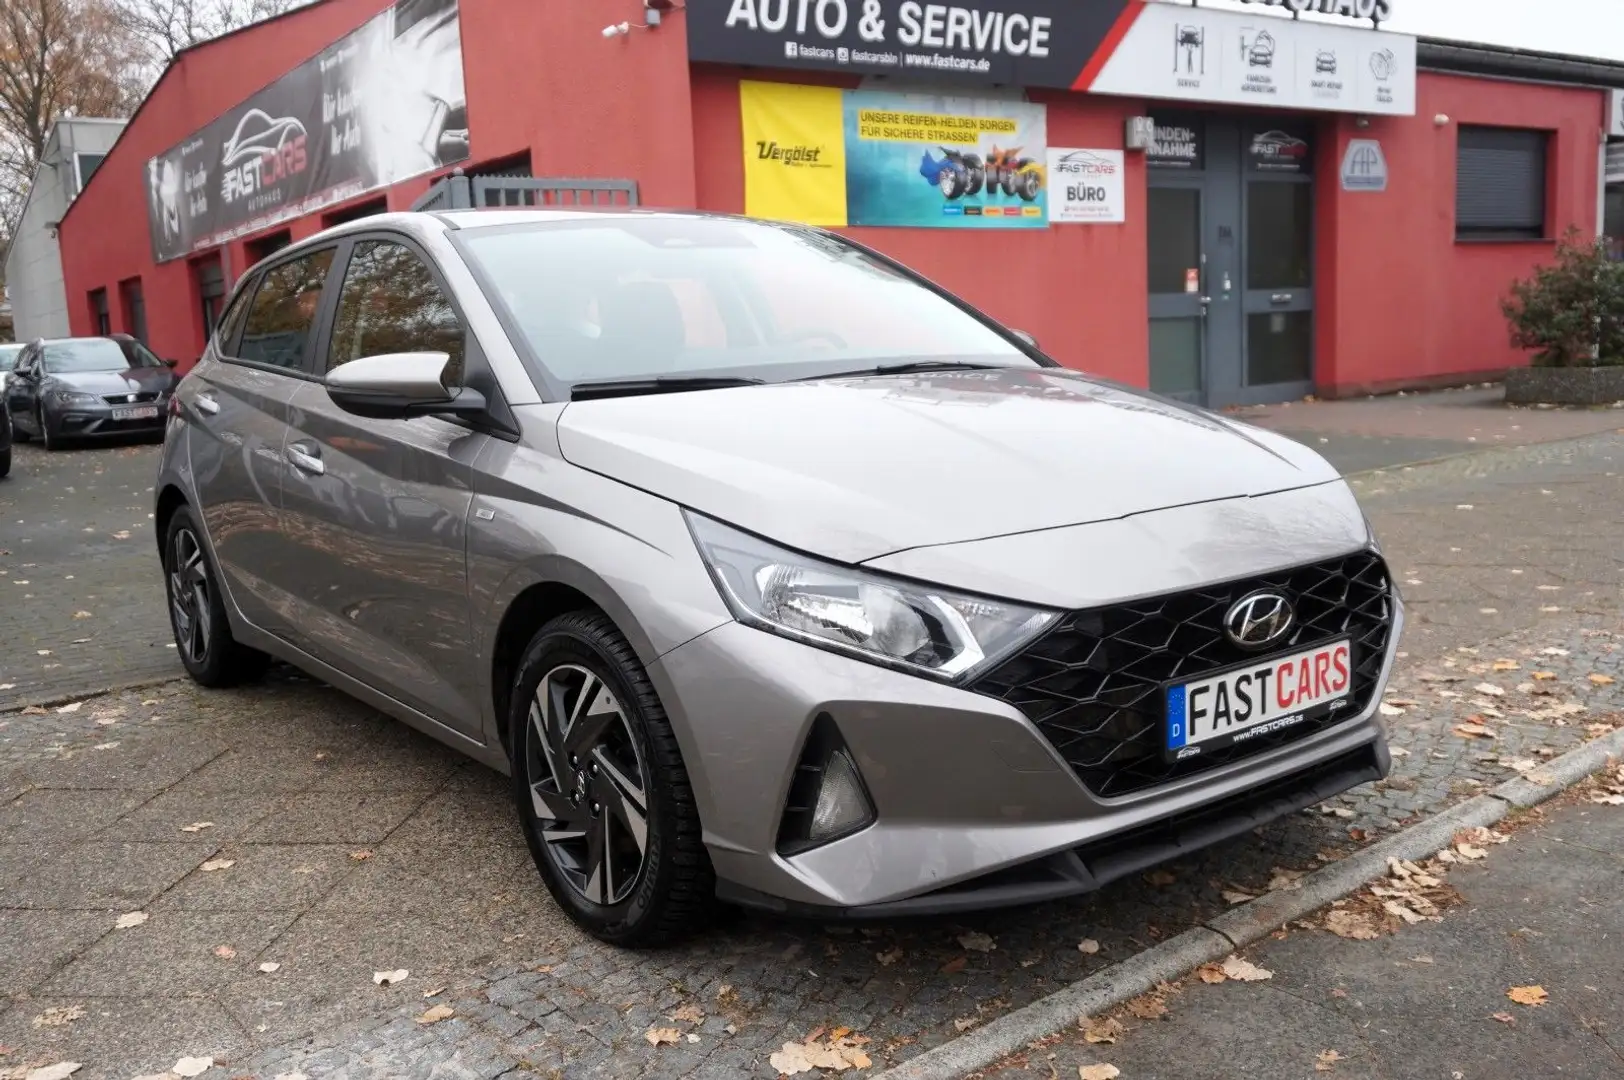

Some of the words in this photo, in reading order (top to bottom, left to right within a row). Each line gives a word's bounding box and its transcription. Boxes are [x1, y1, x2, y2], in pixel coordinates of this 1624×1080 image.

[725, 0, 848, 38] AUTO
[858, 0, 885, 42] &
[897, 1, 1051, 57] SERVICE
[800, 44, 835, 58] fastcars
[905, 53, 990, 71] www.fastcars.de
[861, 112, 900, 124] UNSERE
[903, 114, 977, 129] REIFEN-HELDEN
[979, 119, 1016, 131] SORGEN
[861, 125, 881, 136] FÜR
[883, 127, 924, 139] SICHERE
[927, 129, 976, 143] STRASSEN
[1153, 126, 1196, 142] NDEN-
[756, 141, 821, 165] Vergölst
[221, 134, 307, 203] FASTCARS
[1066, 182, 1106, 202] BÜRO
[1189, 646, 1348, 737] FASTCARS
[1172, 723, 1180, 737] D
